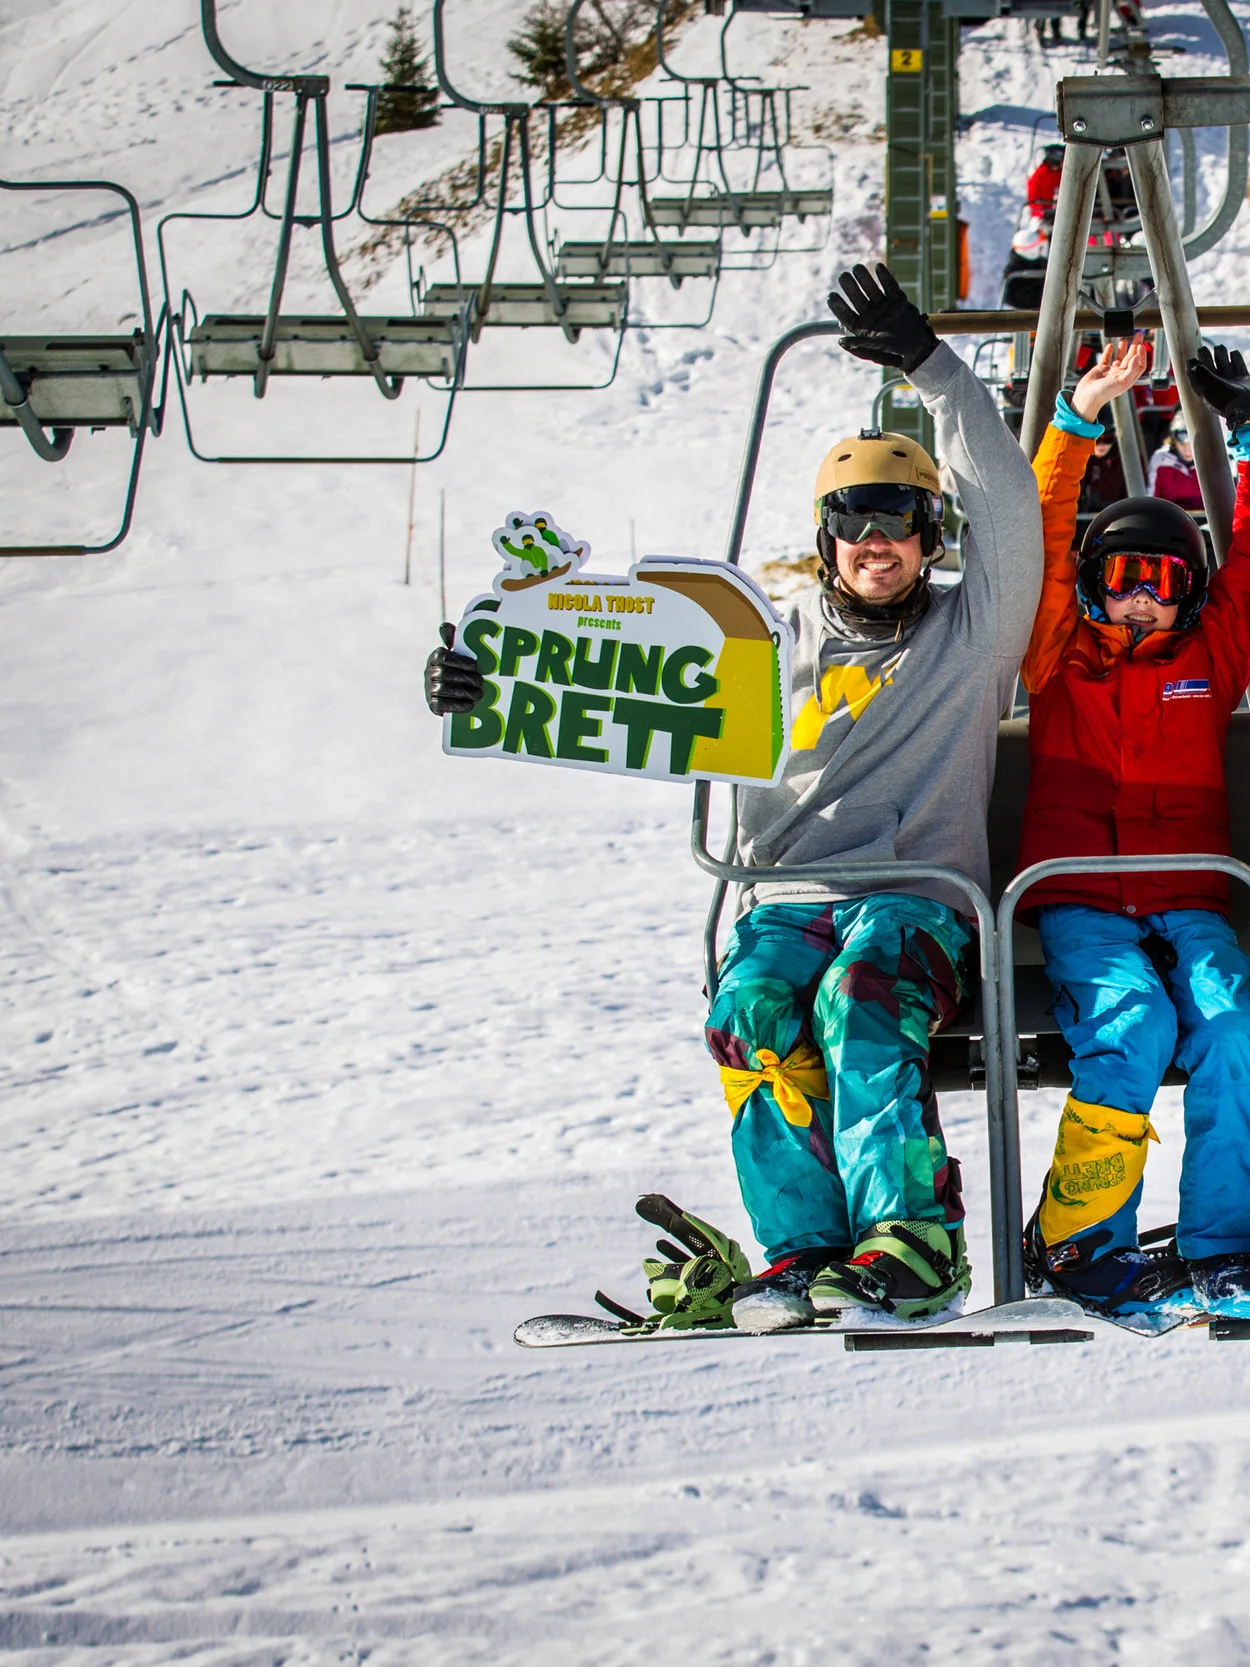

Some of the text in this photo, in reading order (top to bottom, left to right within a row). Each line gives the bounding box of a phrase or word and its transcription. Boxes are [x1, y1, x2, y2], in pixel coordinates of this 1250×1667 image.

[901, 50, 912, 65] 2
[547, 592, 655, 615] NICOLA THOST
[577, 614, 622, 632] presents
[462, 618, 721, 705] SPRUNG
[450, 679, 727, 776] BRETT
[1062, 1152, 1125, 1181] BRETT
